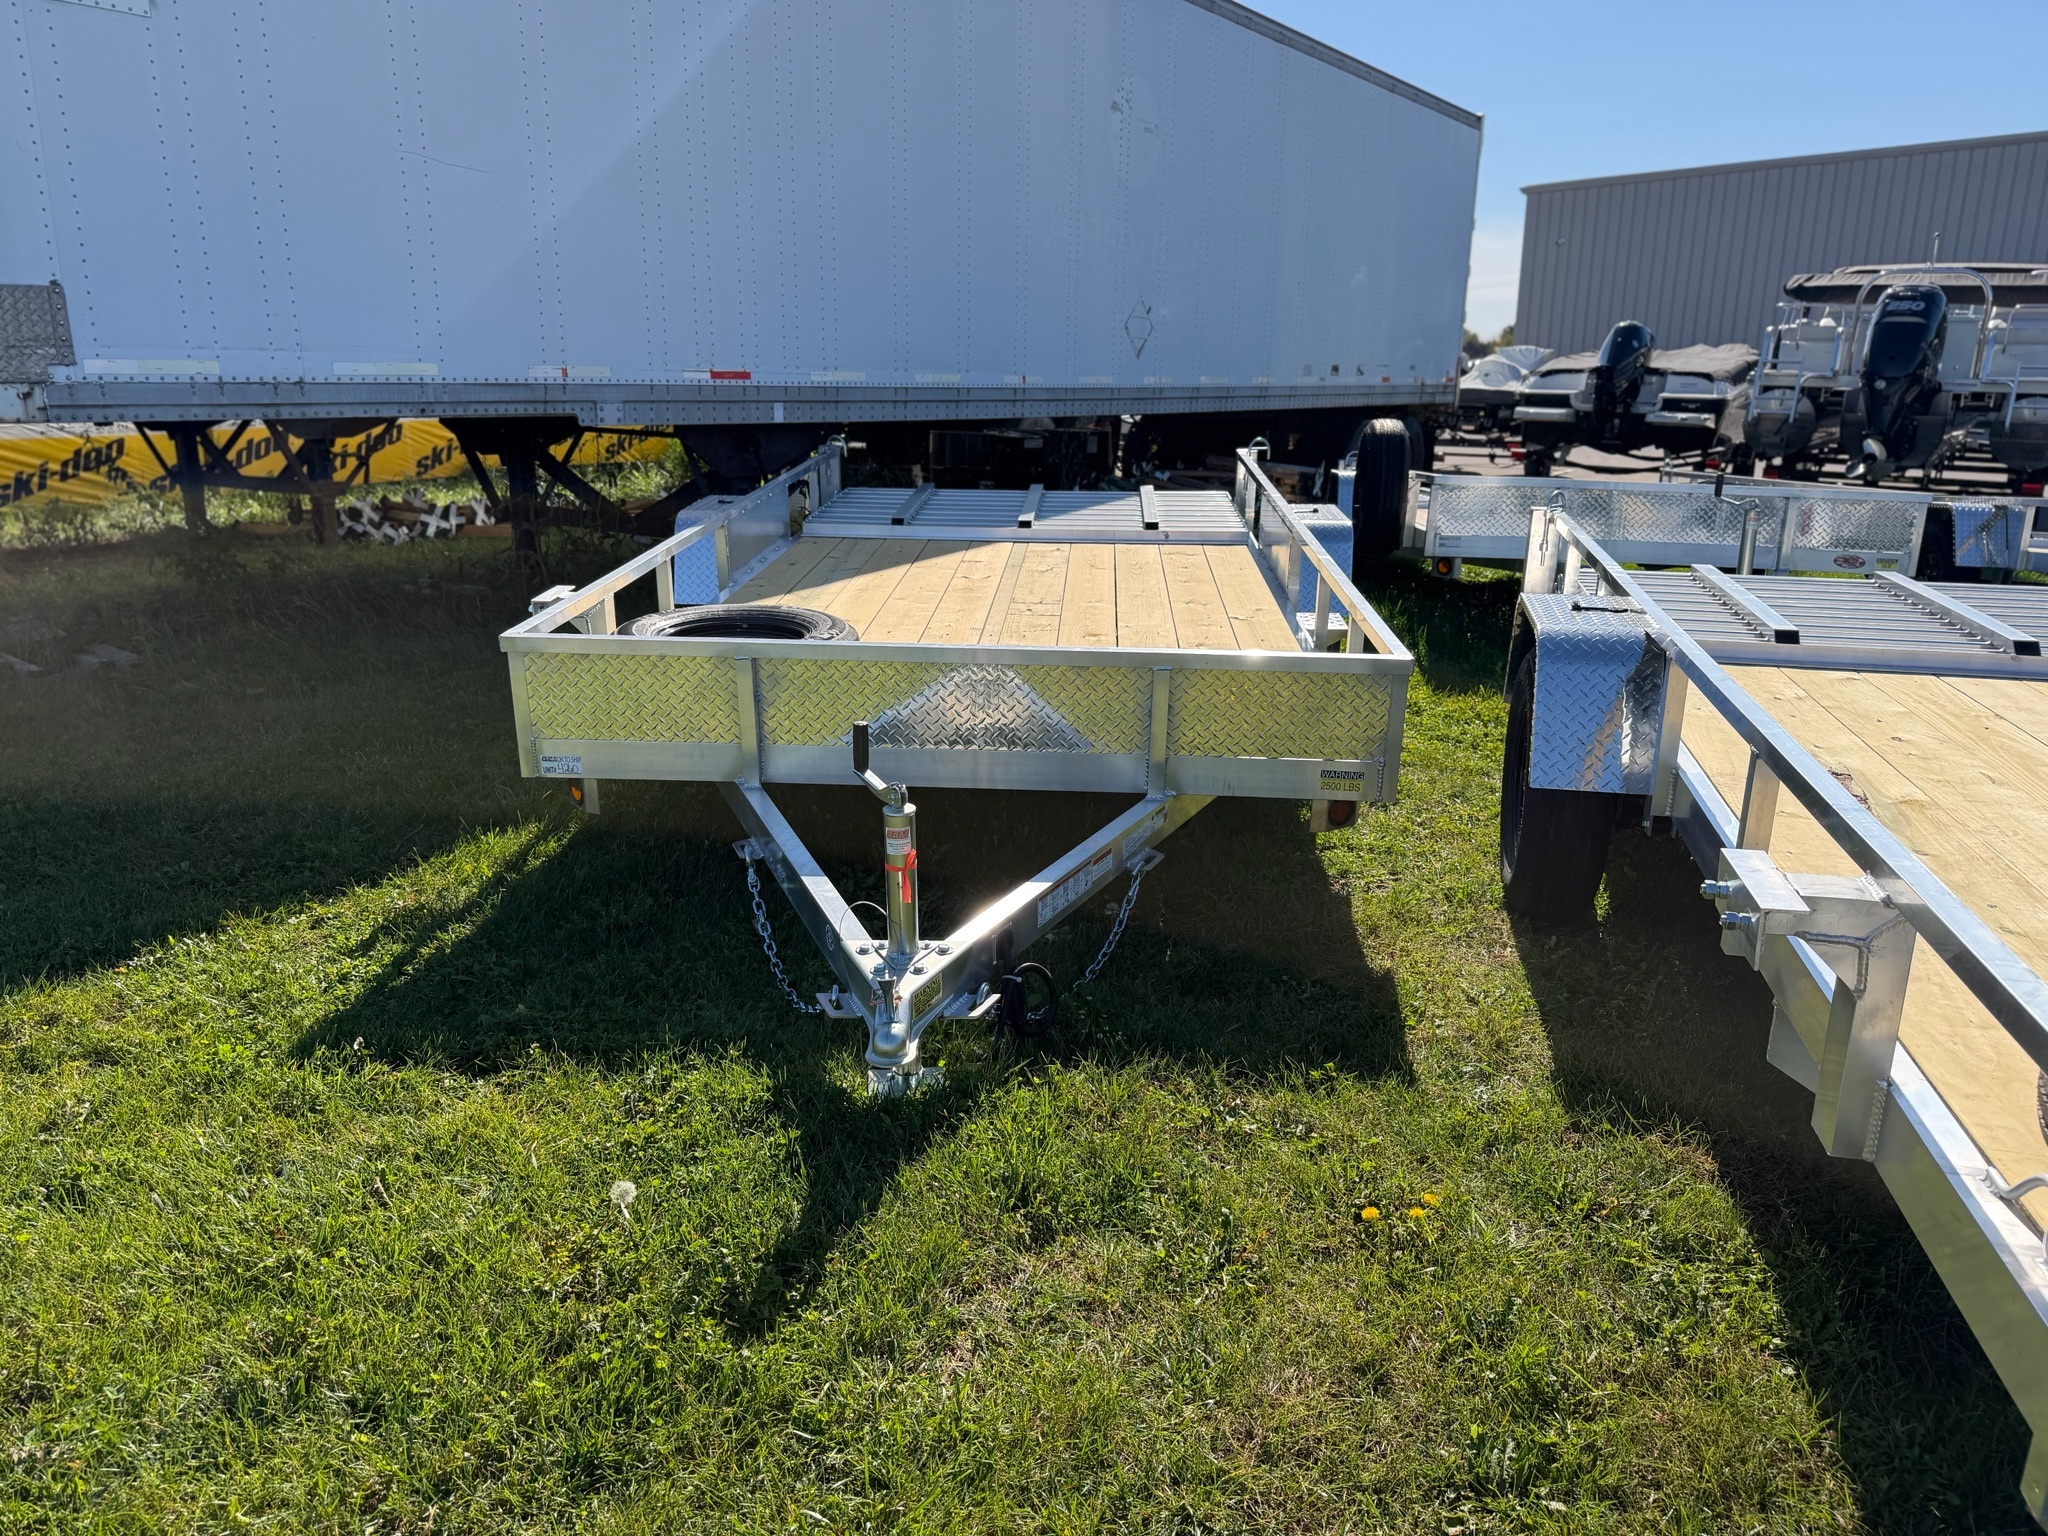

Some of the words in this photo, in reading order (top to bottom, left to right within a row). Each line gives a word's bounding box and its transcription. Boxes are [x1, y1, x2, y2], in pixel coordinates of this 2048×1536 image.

[1885, 301, 1926, 311] 250
[1321, 770, 1364, 780] WARNING
[1321, 781, 1341, 791] 2500
[1343, 782, 1361, 792] LBS
